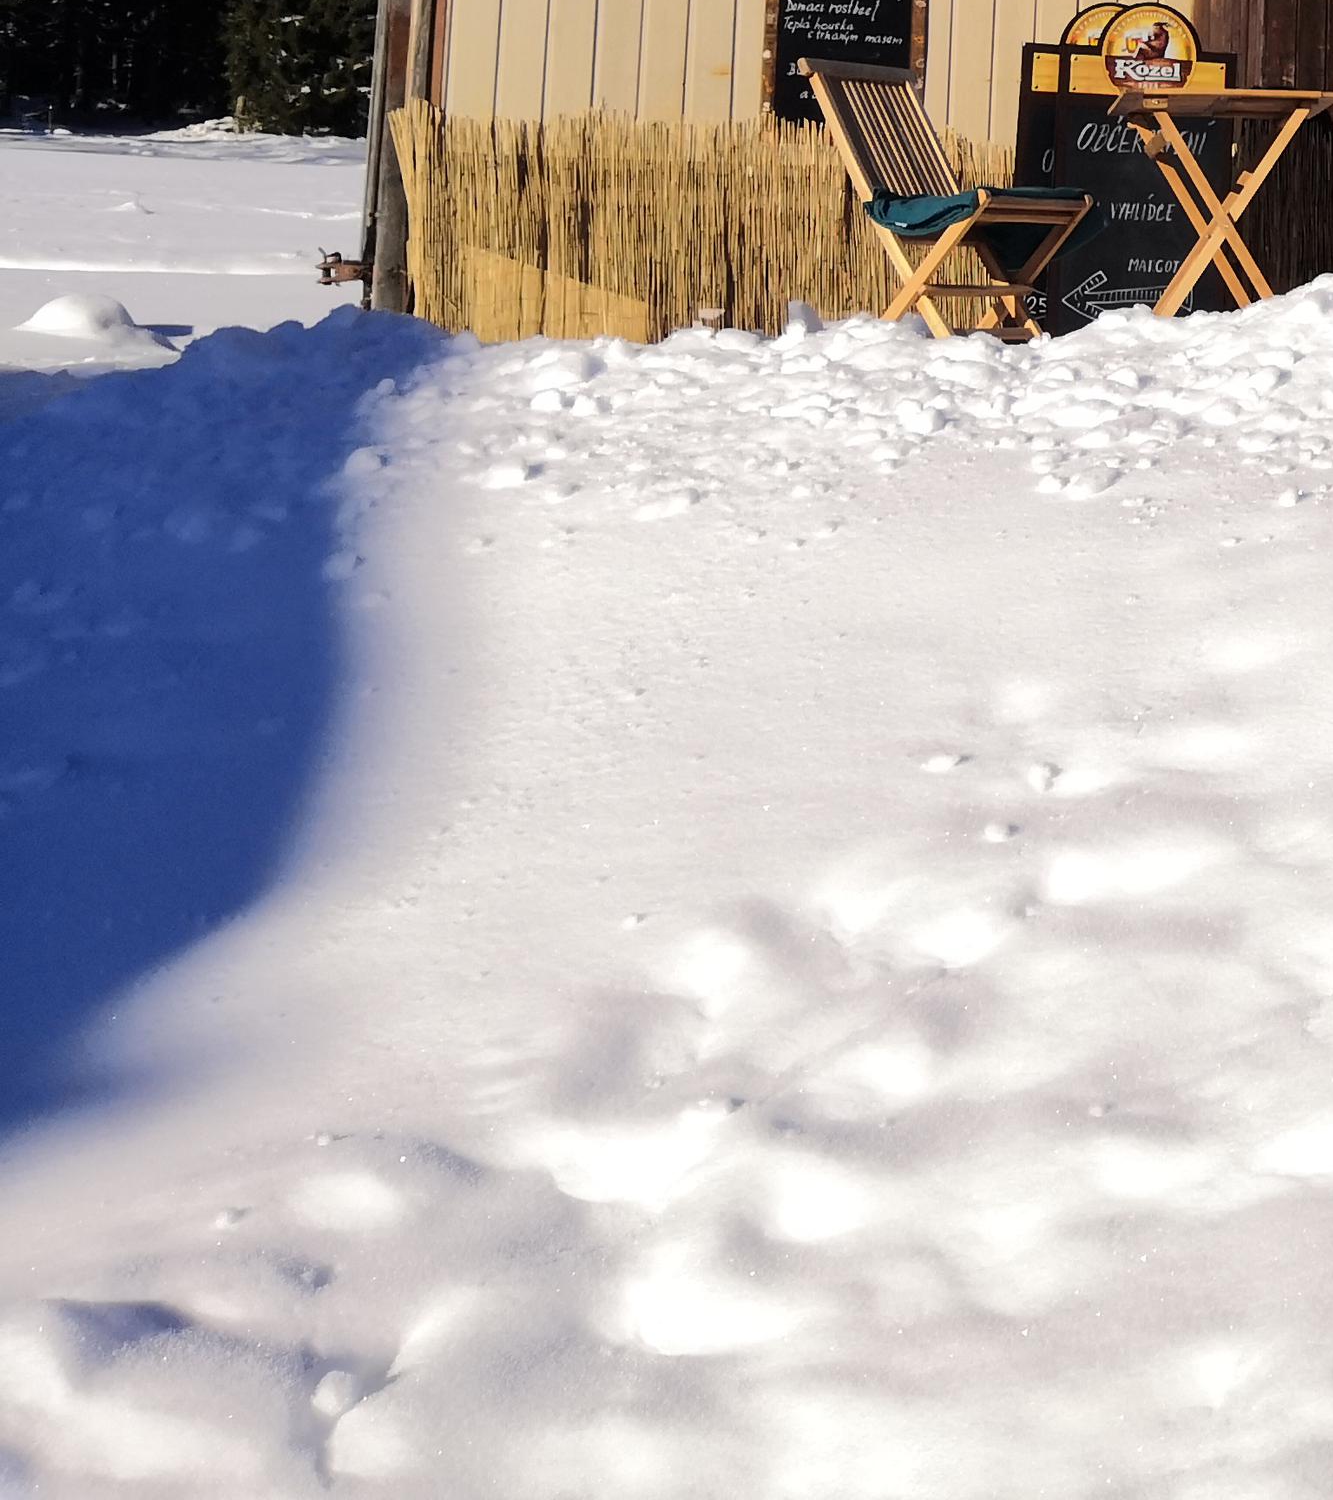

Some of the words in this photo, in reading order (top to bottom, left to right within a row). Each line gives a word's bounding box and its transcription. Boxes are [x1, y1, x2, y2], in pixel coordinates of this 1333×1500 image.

[783, 15, 812, 33] Teplá
[1113, 58, 1182, 83] Kozel
[1110, 193, 1176, 222] VYHLÍDCE
